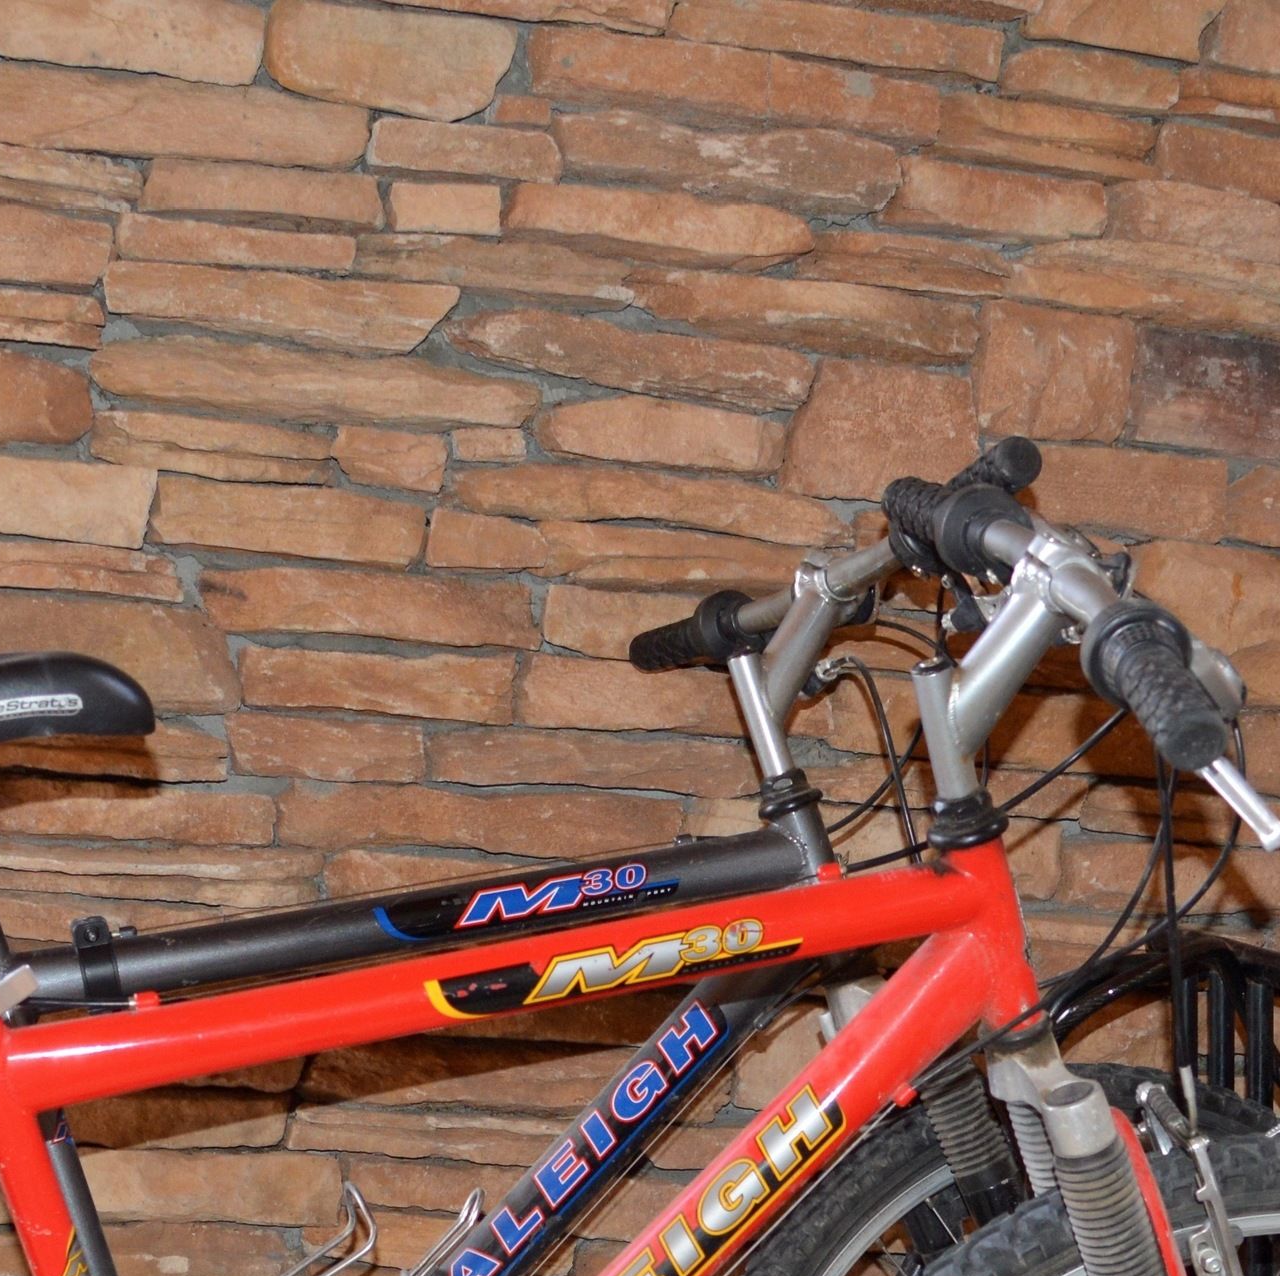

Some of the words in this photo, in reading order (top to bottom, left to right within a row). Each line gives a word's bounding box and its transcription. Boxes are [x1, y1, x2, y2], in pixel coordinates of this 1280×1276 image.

[454, 863, 648, 929] M30
[638, 888, 672, 899] PORT
[522, 918, 764, 1006] M30
